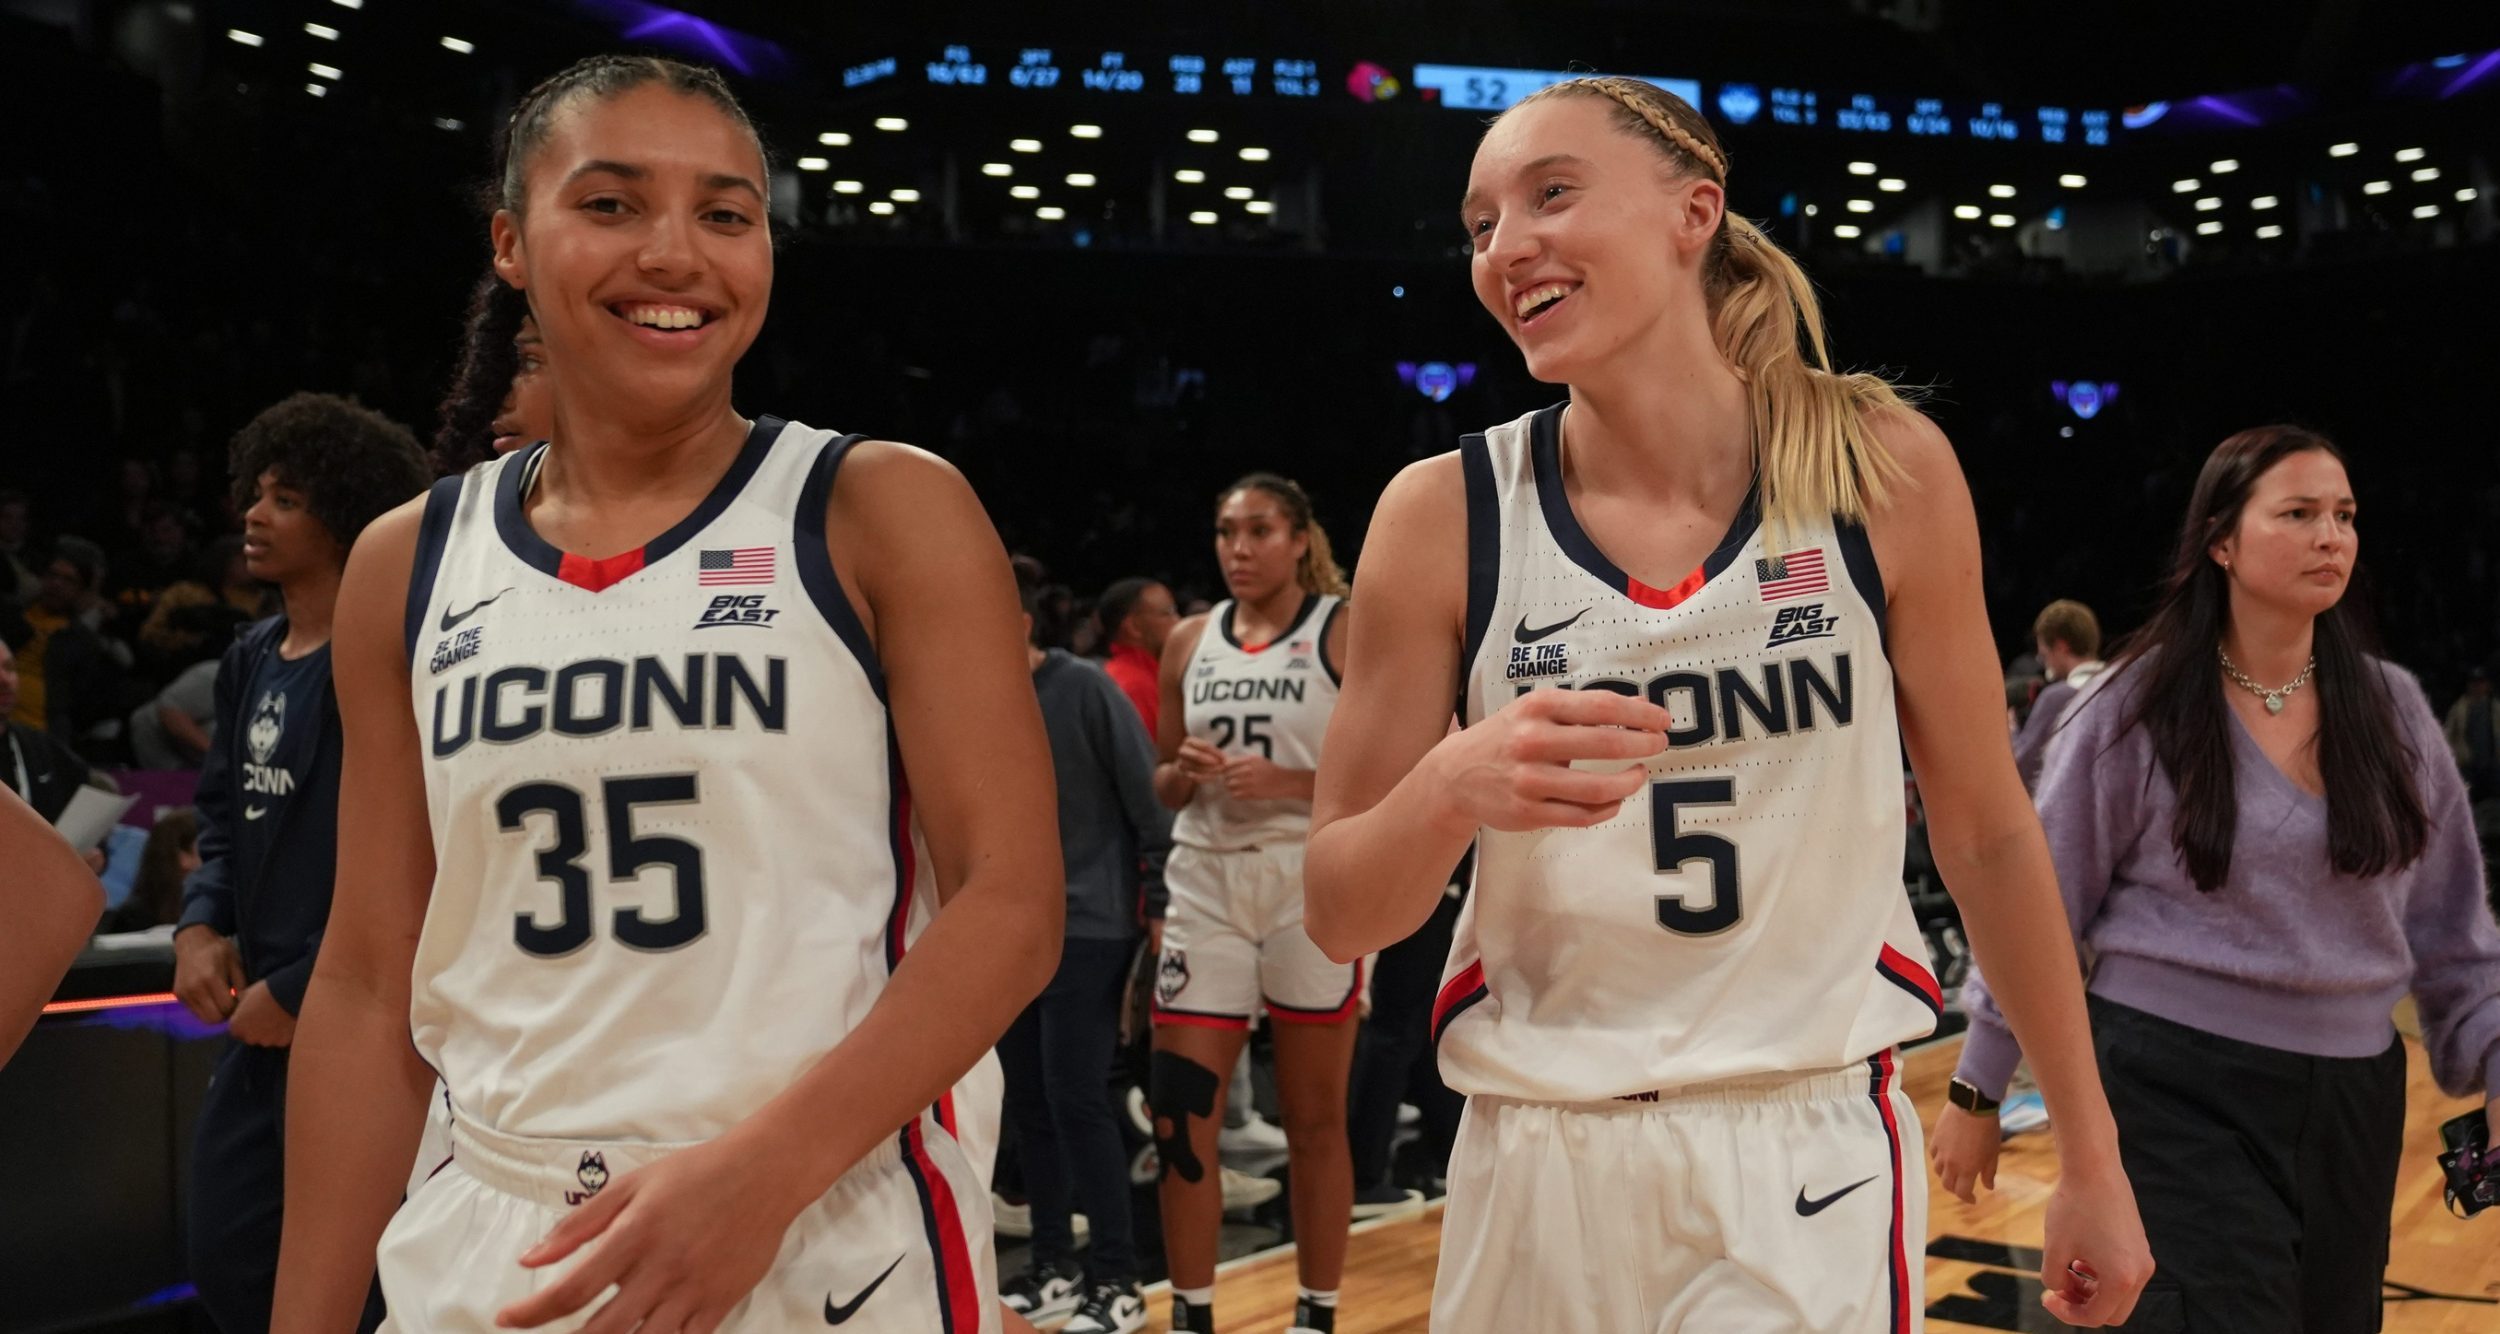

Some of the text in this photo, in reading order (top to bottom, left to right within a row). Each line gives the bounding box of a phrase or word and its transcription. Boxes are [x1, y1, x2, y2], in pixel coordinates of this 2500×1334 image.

[1466, 78, 1507, 105] 52
[700, 608, 780, 624] EAST
[709, 595, 766, 609] BIG
[1775, 604, 1825, 625] BIG
[435, 626, 484, 656] BE THE
[1770, 616, 1839, 640] EAST
[430, 640, 482, 674] CHANGE
[1511, 643, 1567, 662] BE THE
[1506, 658, 1568, 679] CHANGE
[1193, 677, 1305, 704] UCONN
[1514, 651, 1854, 751] ONN
[433, 652, 789, 759] UCONN
[1209, 714, 1273, 761] 25
[243, 762, 295, 796] CONN
[495, 771, 710, 960] 35
[1649, 775, 1744, 938] 5
